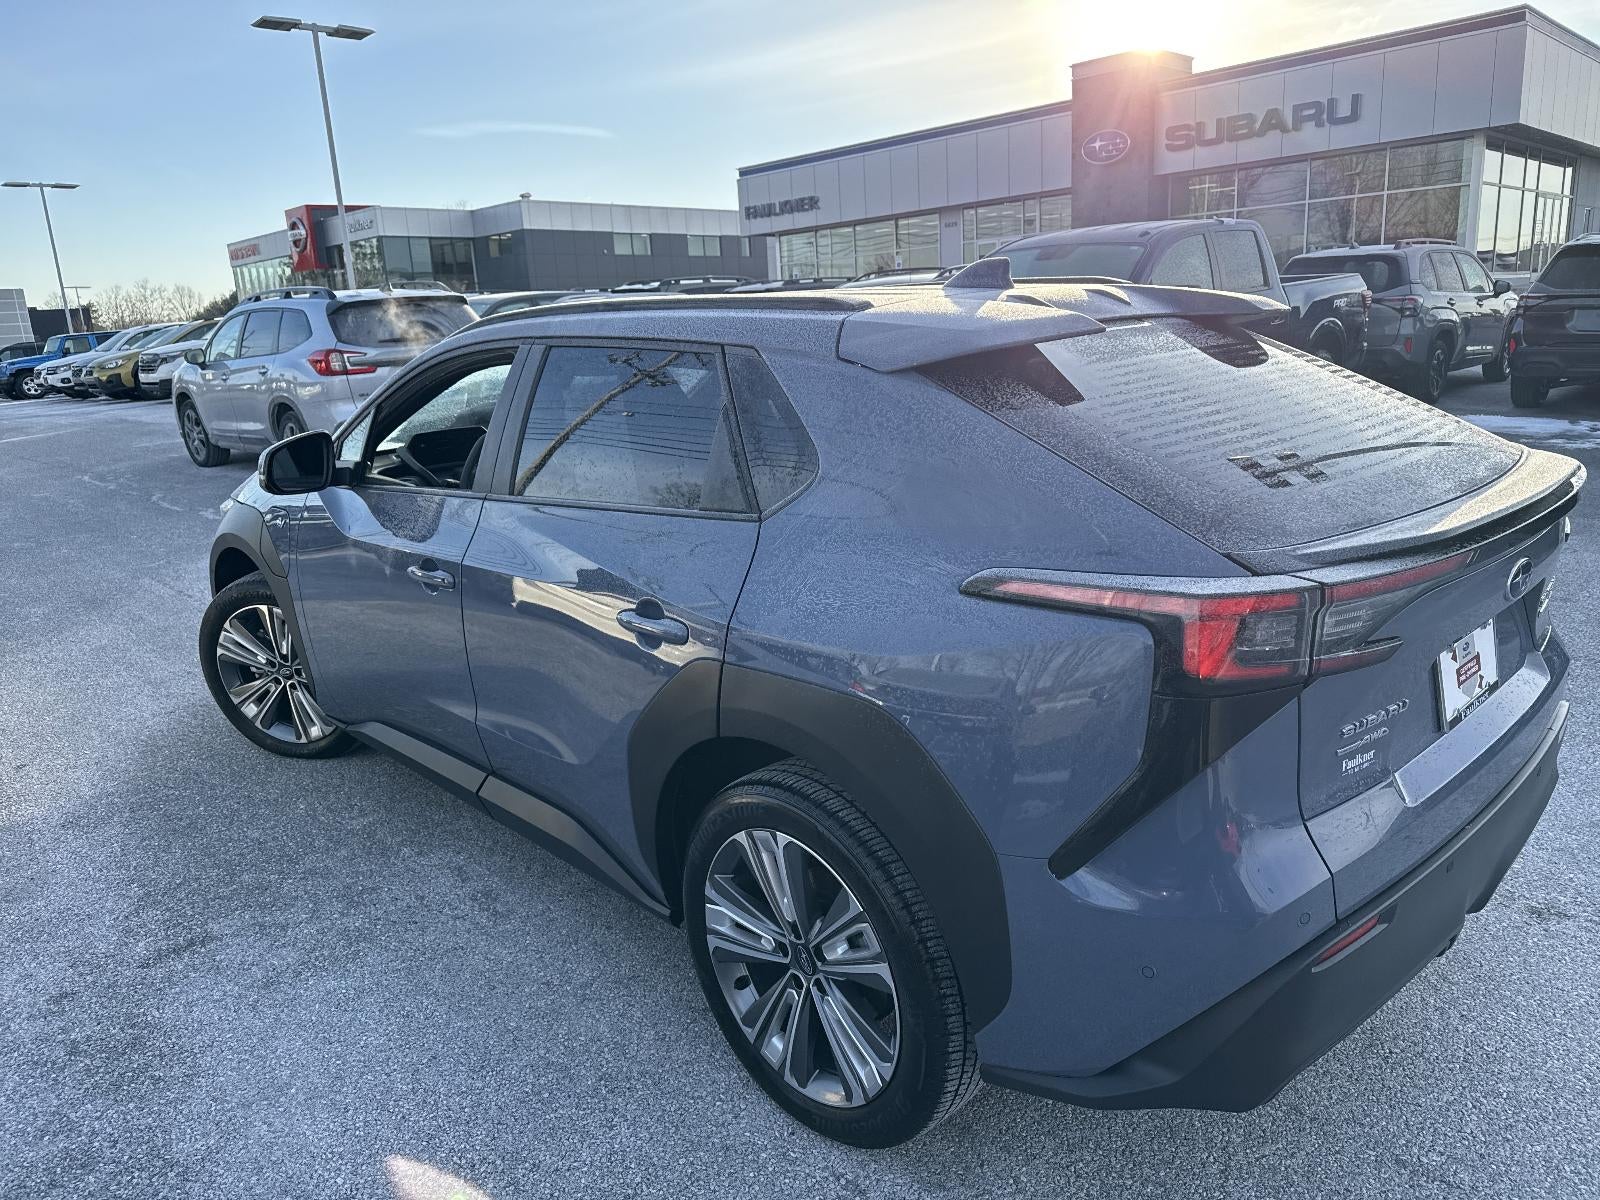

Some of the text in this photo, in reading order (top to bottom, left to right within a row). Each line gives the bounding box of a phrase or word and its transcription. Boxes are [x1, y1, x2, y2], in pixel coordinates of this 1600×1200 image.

[1165, 93, 1363, 152] SUBARU
[744, 195, 821, 221] FAULKNER
[1340, 698, 1409, 738] SUBARU
[1461, 690, 1490, 721] Faulkner
[1342, 749, 1376, 772] Faulkner
